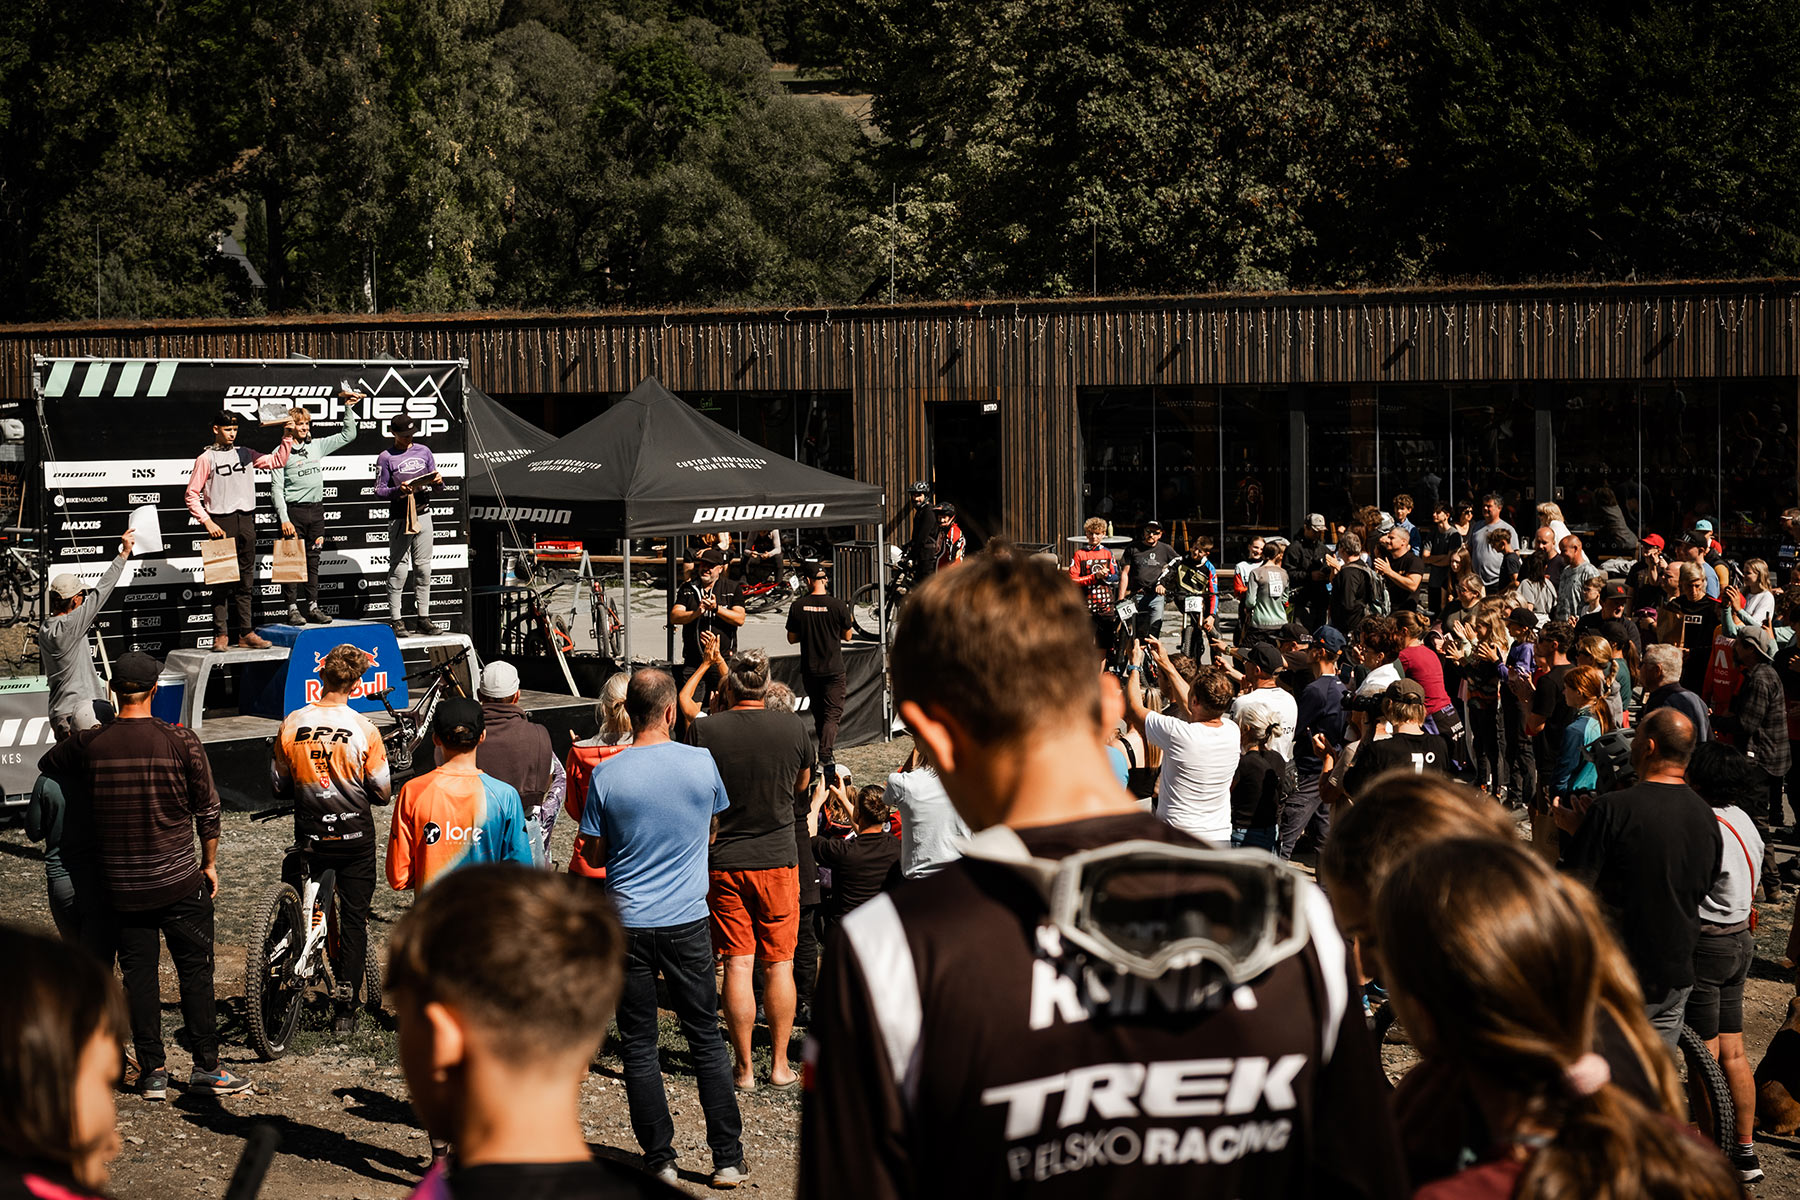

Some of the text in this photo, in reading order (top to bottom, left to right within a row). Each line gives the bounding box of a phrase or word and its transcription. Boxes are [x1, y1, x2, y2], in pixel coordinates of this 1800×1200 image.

[226, 386, 334, 397] PROPAIN
[224, 397, 438, 421] ROKIES
[676, 456, 767, 469] CUSTOM HANDCRAFTED
[694, 461, 737, 472] MOUNTAIN
[66, 496, 108, 504] BIKEMAILORDER
[470, 505, 572, 525] PROPAIN
[692, 503, 826, 524] PROPAIN
[61, 520, 102, 531] MAXXIS
[1122, 605, 1132, 615] 16
[294, 726, 354, 744] BPR
[446, 821, 484, 842] lore
[981, 1053, 1308, 1141] TREK
